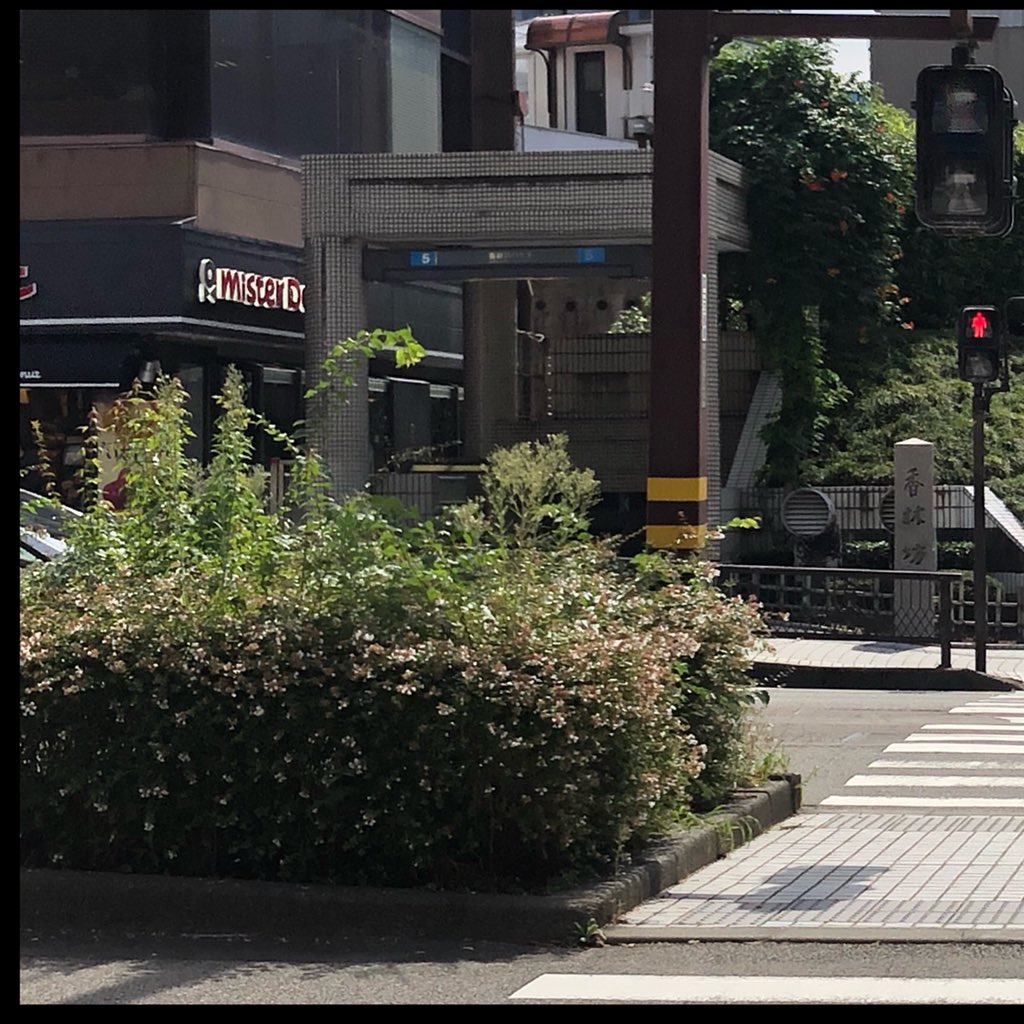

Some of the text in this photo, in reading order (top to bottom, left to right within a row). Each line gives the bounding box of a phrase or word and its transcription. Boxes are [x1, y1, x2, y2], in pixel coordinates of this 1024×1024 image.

[421, 252, 431, 264] 5
[902, 466, 926, 566] 香林坊
